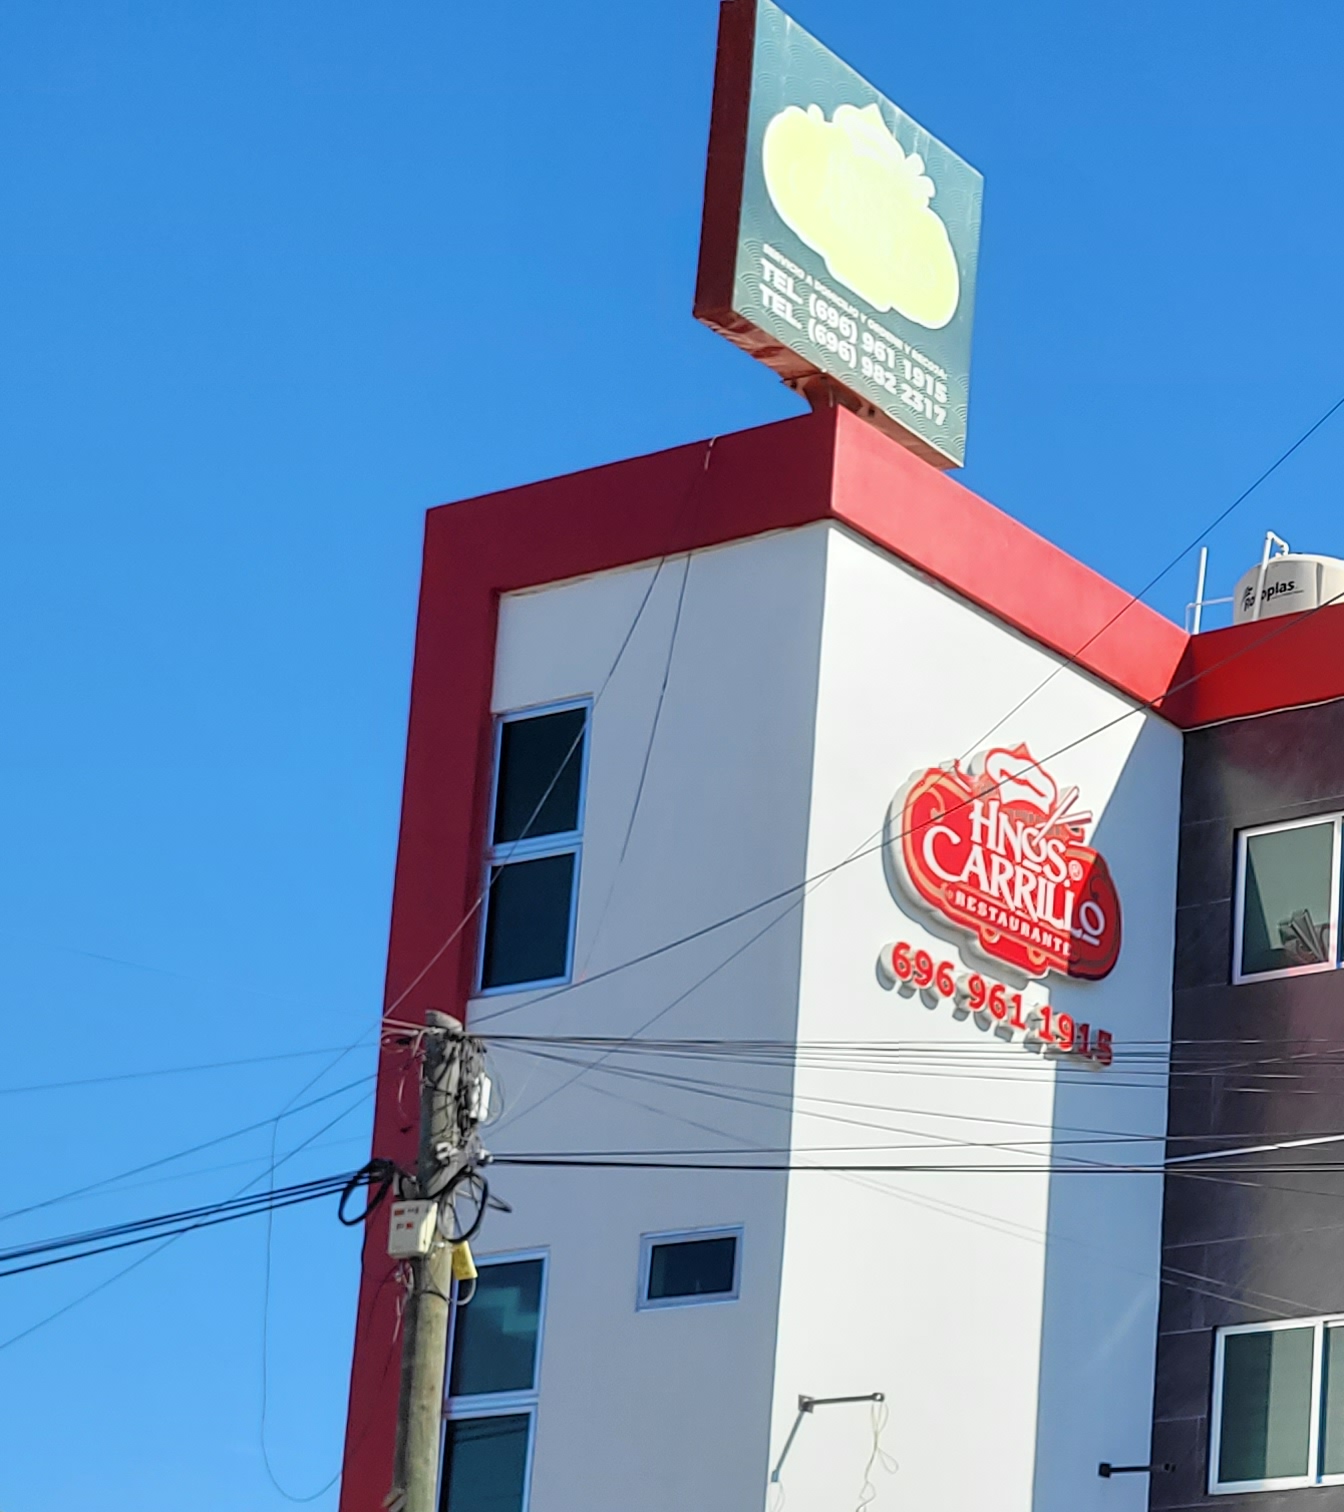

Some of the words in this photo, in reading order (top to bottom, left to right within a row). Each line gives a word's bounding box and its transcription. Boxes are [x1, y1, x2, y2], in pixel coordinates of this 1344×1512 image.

[808, 317, 857, 369] (696)
[861, 356, 898, 395] 982
[901, 383, 947, 426] 2317
[809, 293, 858, 345] (696)
[862, 331, 896, 369] 961
[903, 359, 948, 404] 1915
[923, 826, 1106, 946] CARRILLO
[955, 890, 1071, 956] RESTAURANTE
[892, 941, 956, 998] 696
[968, 973, 1027, 1030] 961
[1038, 1006, 1113, 1067] 1915
